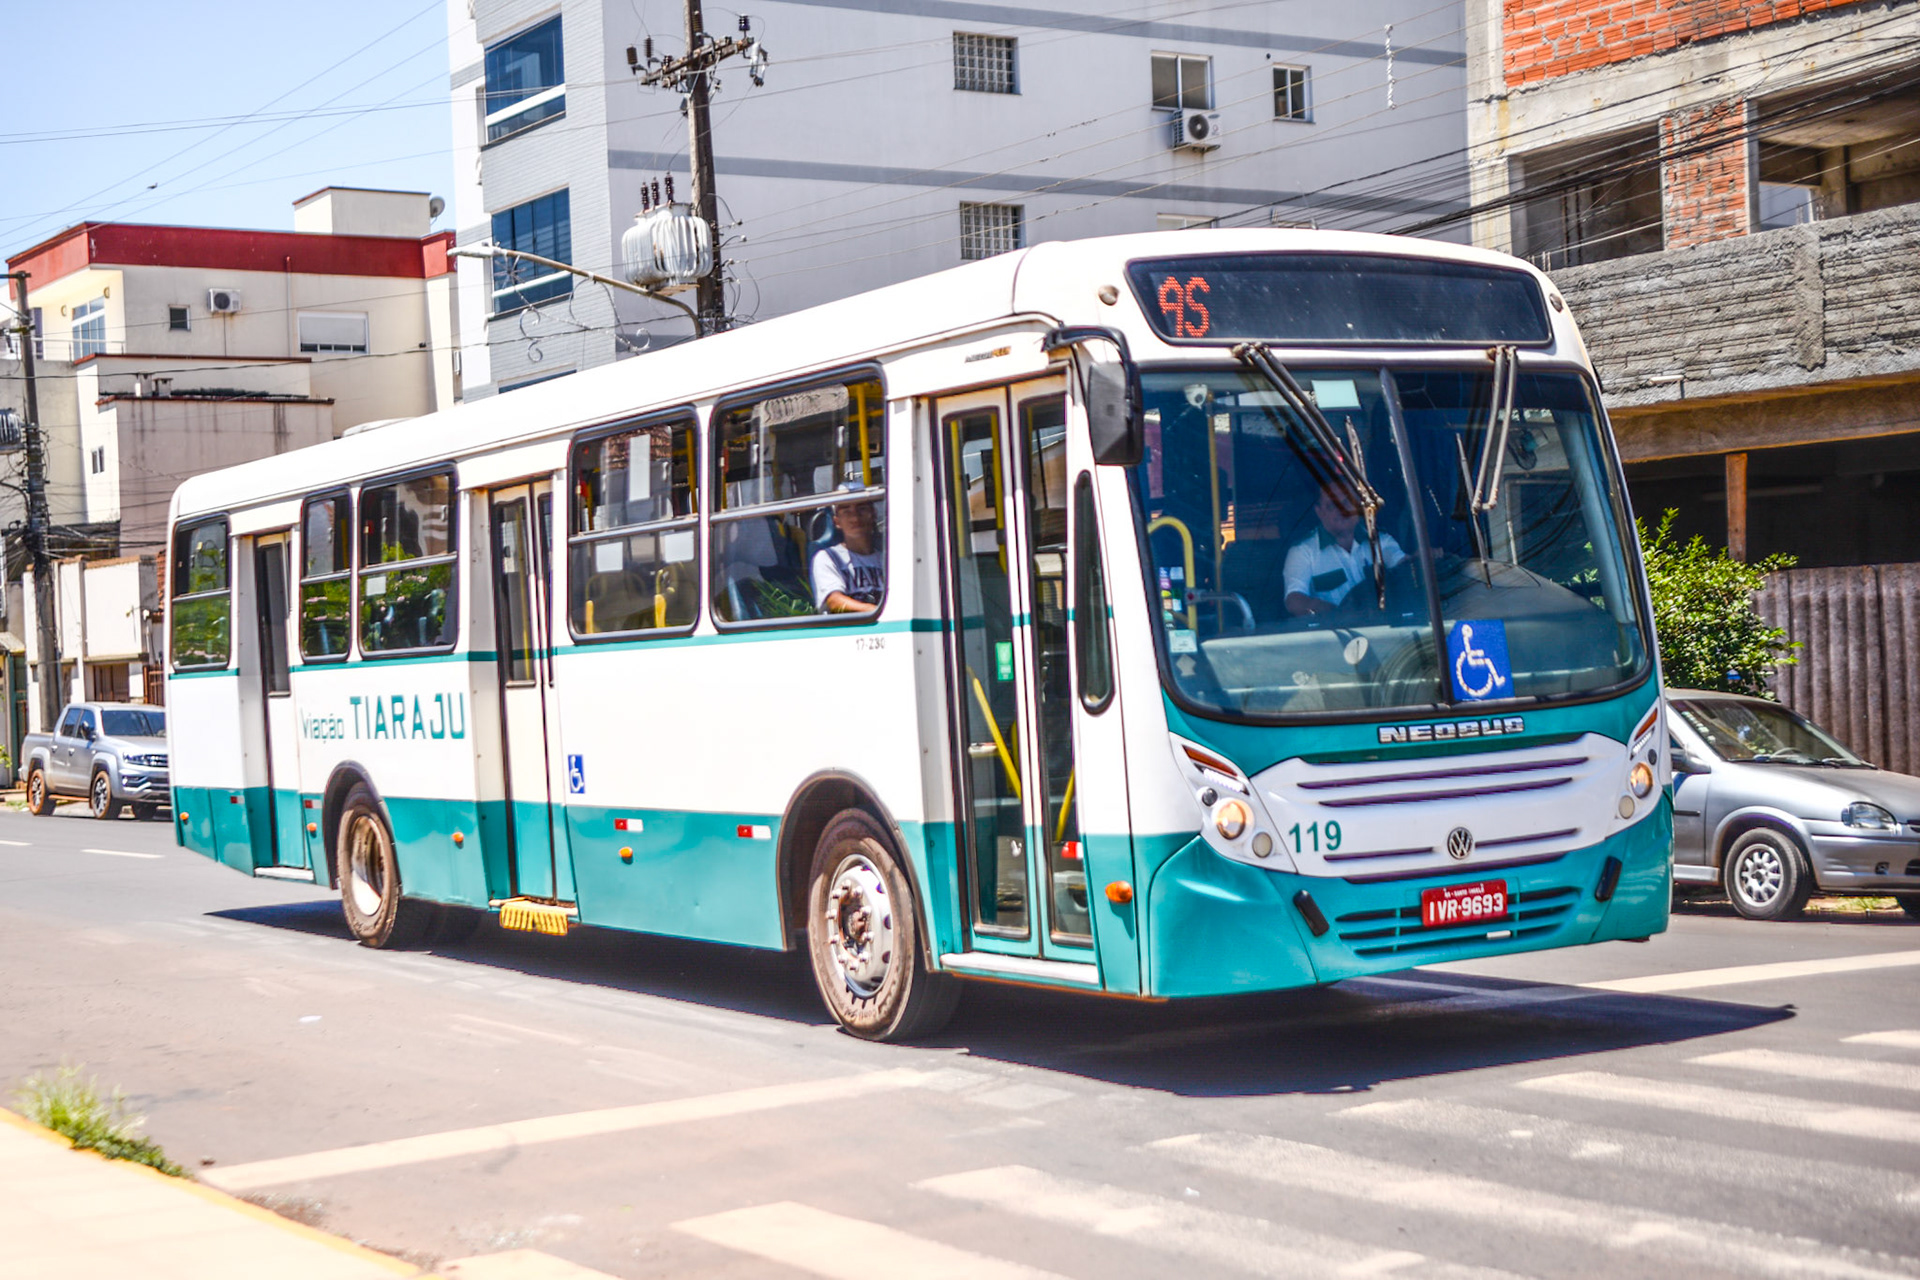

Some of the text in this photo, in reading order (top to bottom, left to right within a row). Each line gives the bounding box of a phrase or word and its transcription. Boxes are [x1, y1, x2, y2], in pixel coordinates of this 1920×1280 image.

[350, 692, 465, 740] TIARAJU
[1378, 716, 1525, 743] NEOBUS
[1289, 820, 1341, 853] 119
